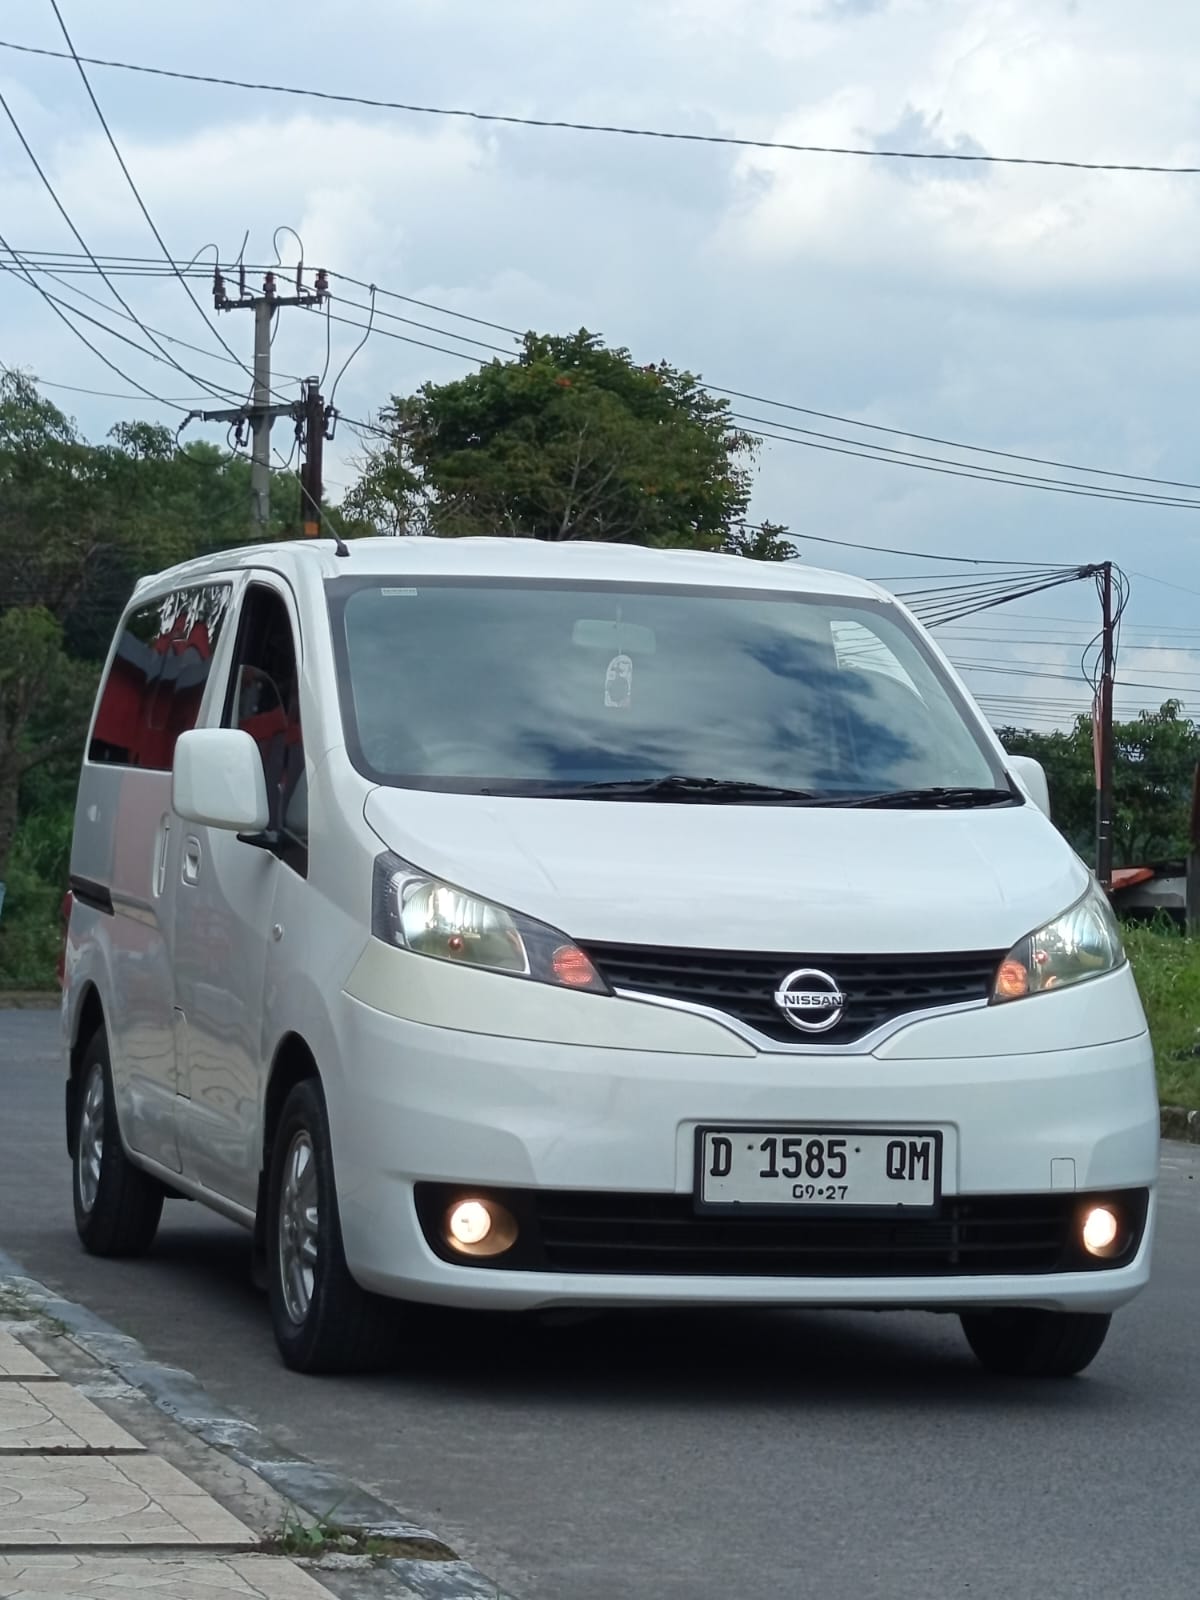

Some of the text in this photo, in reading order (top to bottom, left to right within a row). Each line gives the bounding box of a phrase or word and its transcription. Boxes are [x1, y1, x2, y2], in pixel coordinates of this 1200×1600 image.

[783, 995, 842, 1006] NISSAN
[710, 1137, 931, 1181] D 1585 QM
